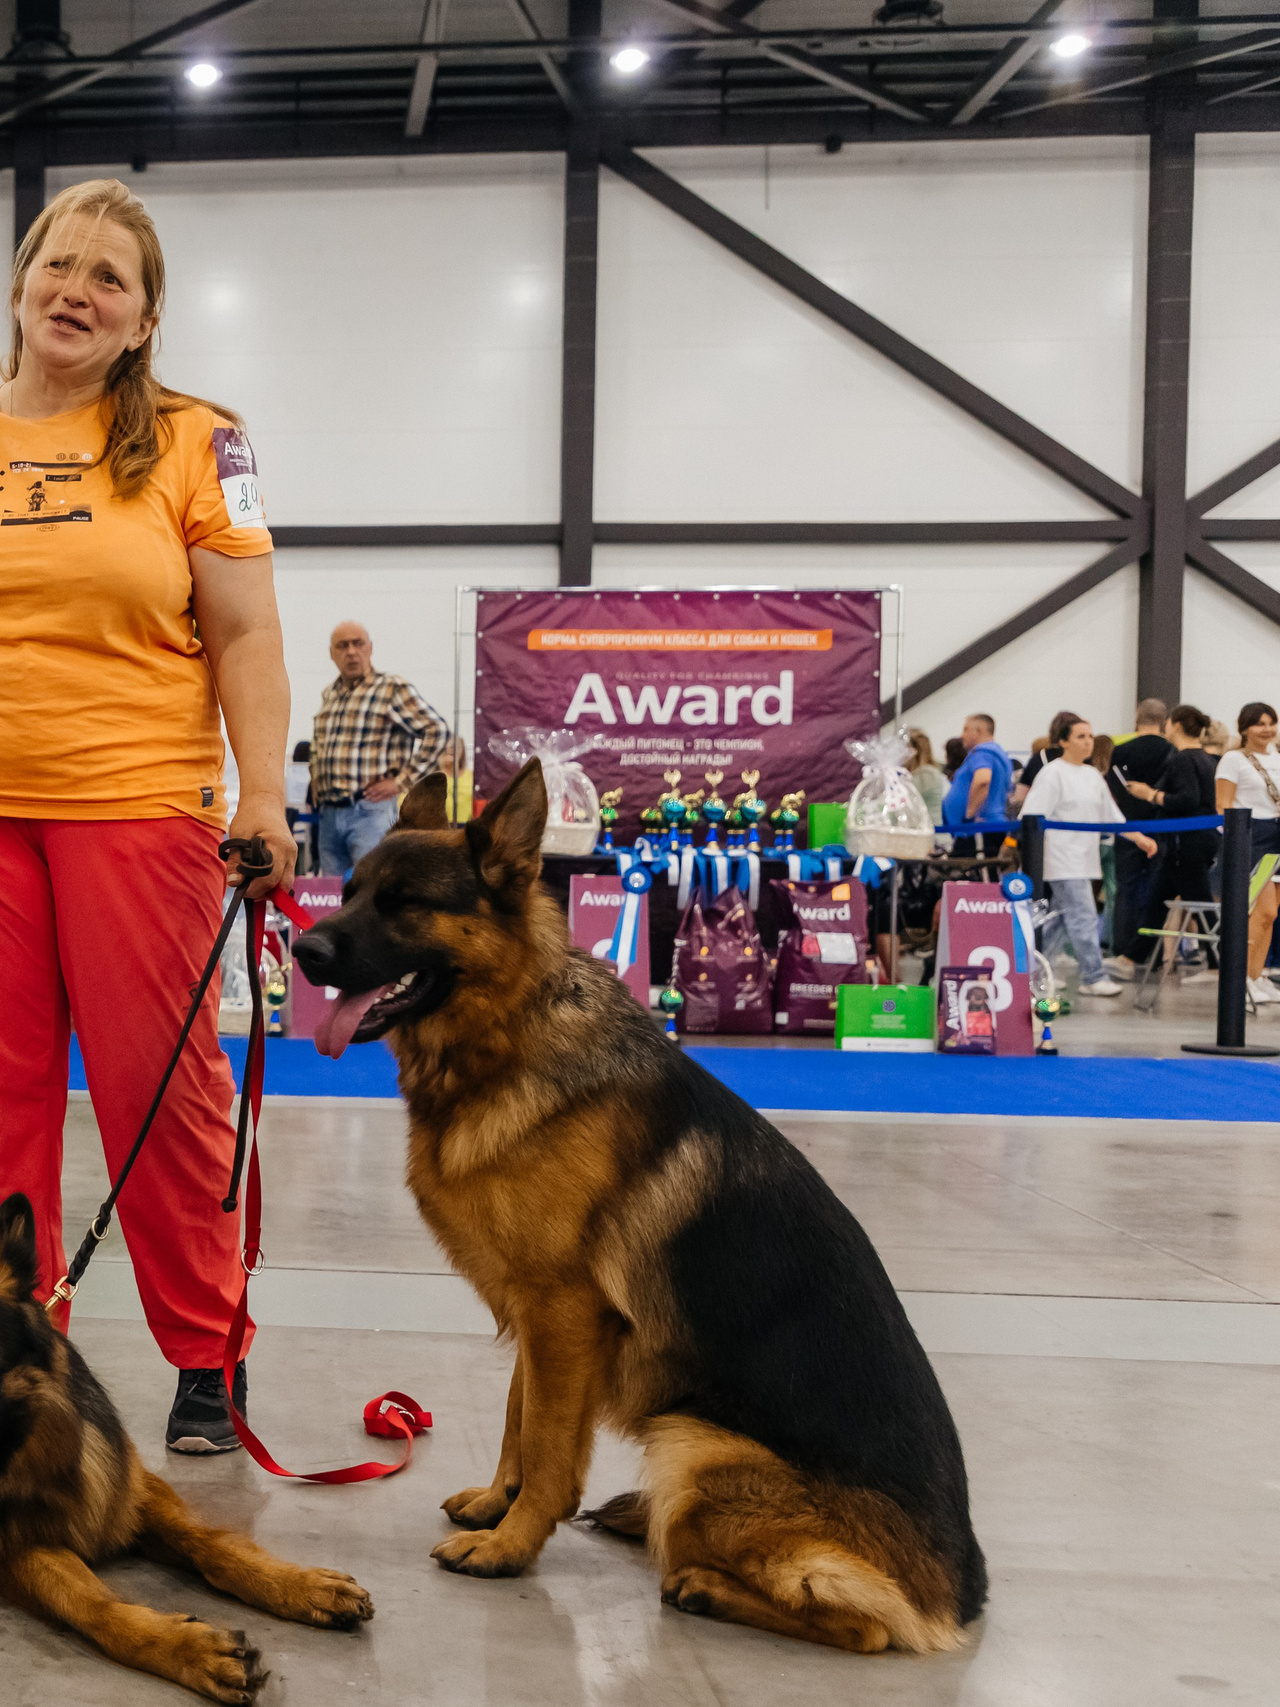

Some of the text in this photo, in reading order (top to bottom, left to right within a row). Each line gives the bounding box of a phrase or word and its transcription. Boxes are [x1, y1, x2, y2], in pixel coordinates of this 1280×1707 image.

[541, 633, 818, 647] КОРМА СУПЕРПРЕМИУМ КЛАССА ДЛЯ СОБАК И КОШЕК
[563, 670, 794, 726] Award
[637, 738, 685, 751] ПИТОМЕЦ
[693, 738, 712, 750] ЭТО
[620, 752, 680, 766] ДОСТОЙНЫЙ
[967, 945, 1013, 1012] 3
[789, 983, 833, 994] BREEDER
[944, 980, 961, 1031] Award
